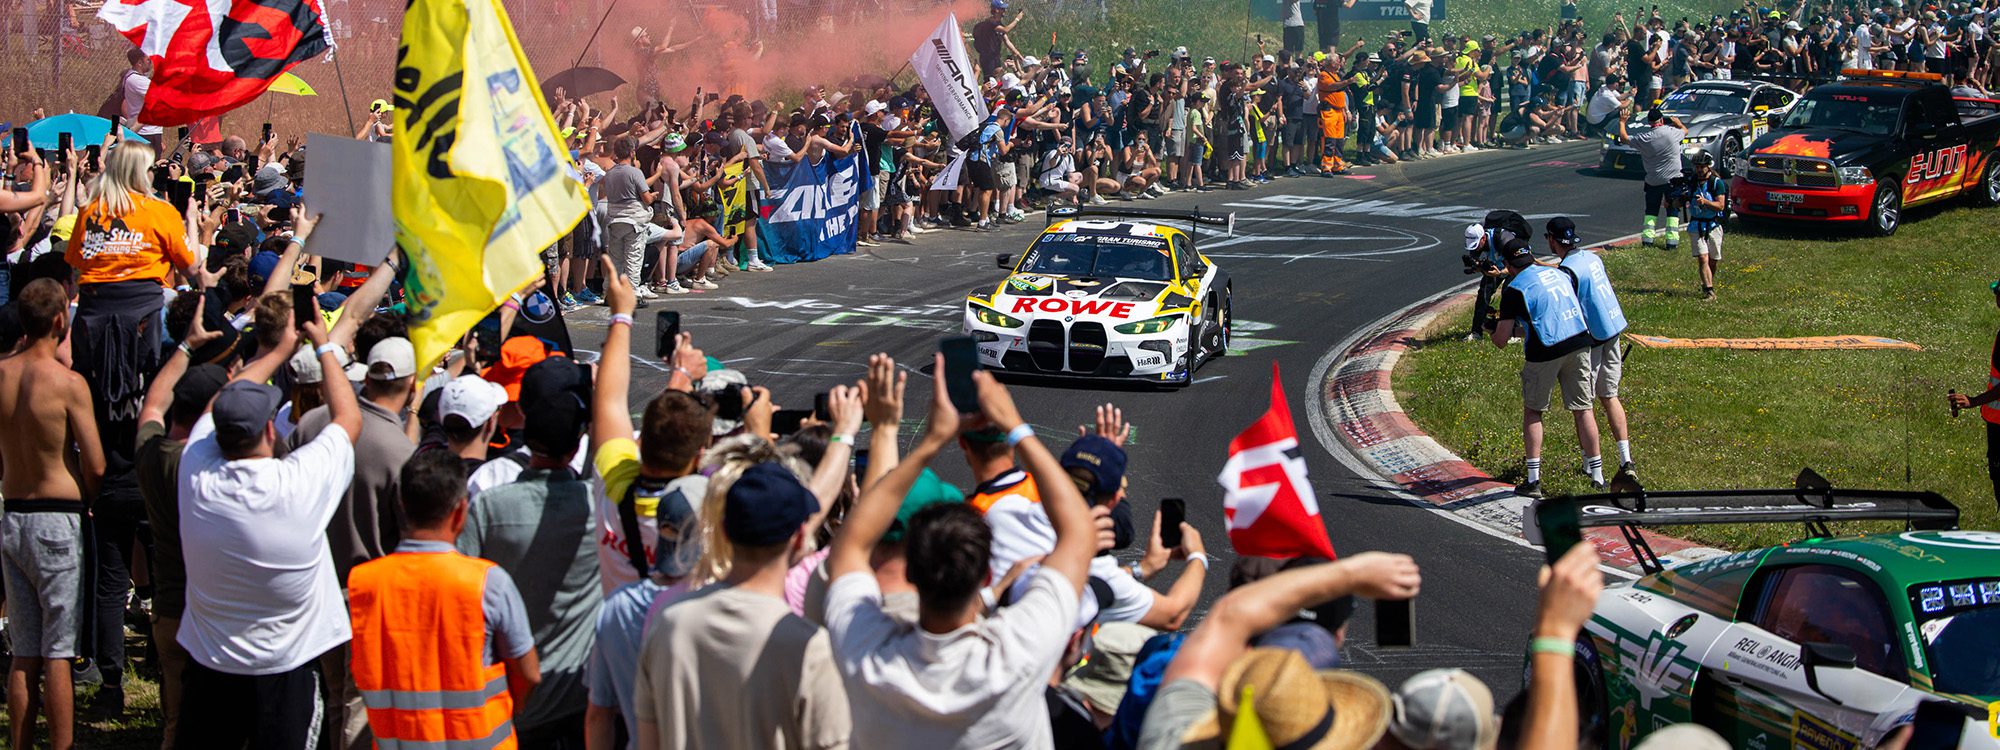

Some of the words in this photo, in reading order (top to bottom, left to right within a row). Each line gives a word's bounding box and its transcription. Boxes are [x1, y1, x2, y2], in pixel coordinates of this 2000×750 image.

[947, 82, 973, 121] PERFORMANCE
[1547, 285, 1570, 302] TV
[1011, 297, 1136, 319] ROWE
[1562, 307, 1579, 321] 126
[1734, 637, 1761, 655] REIL
